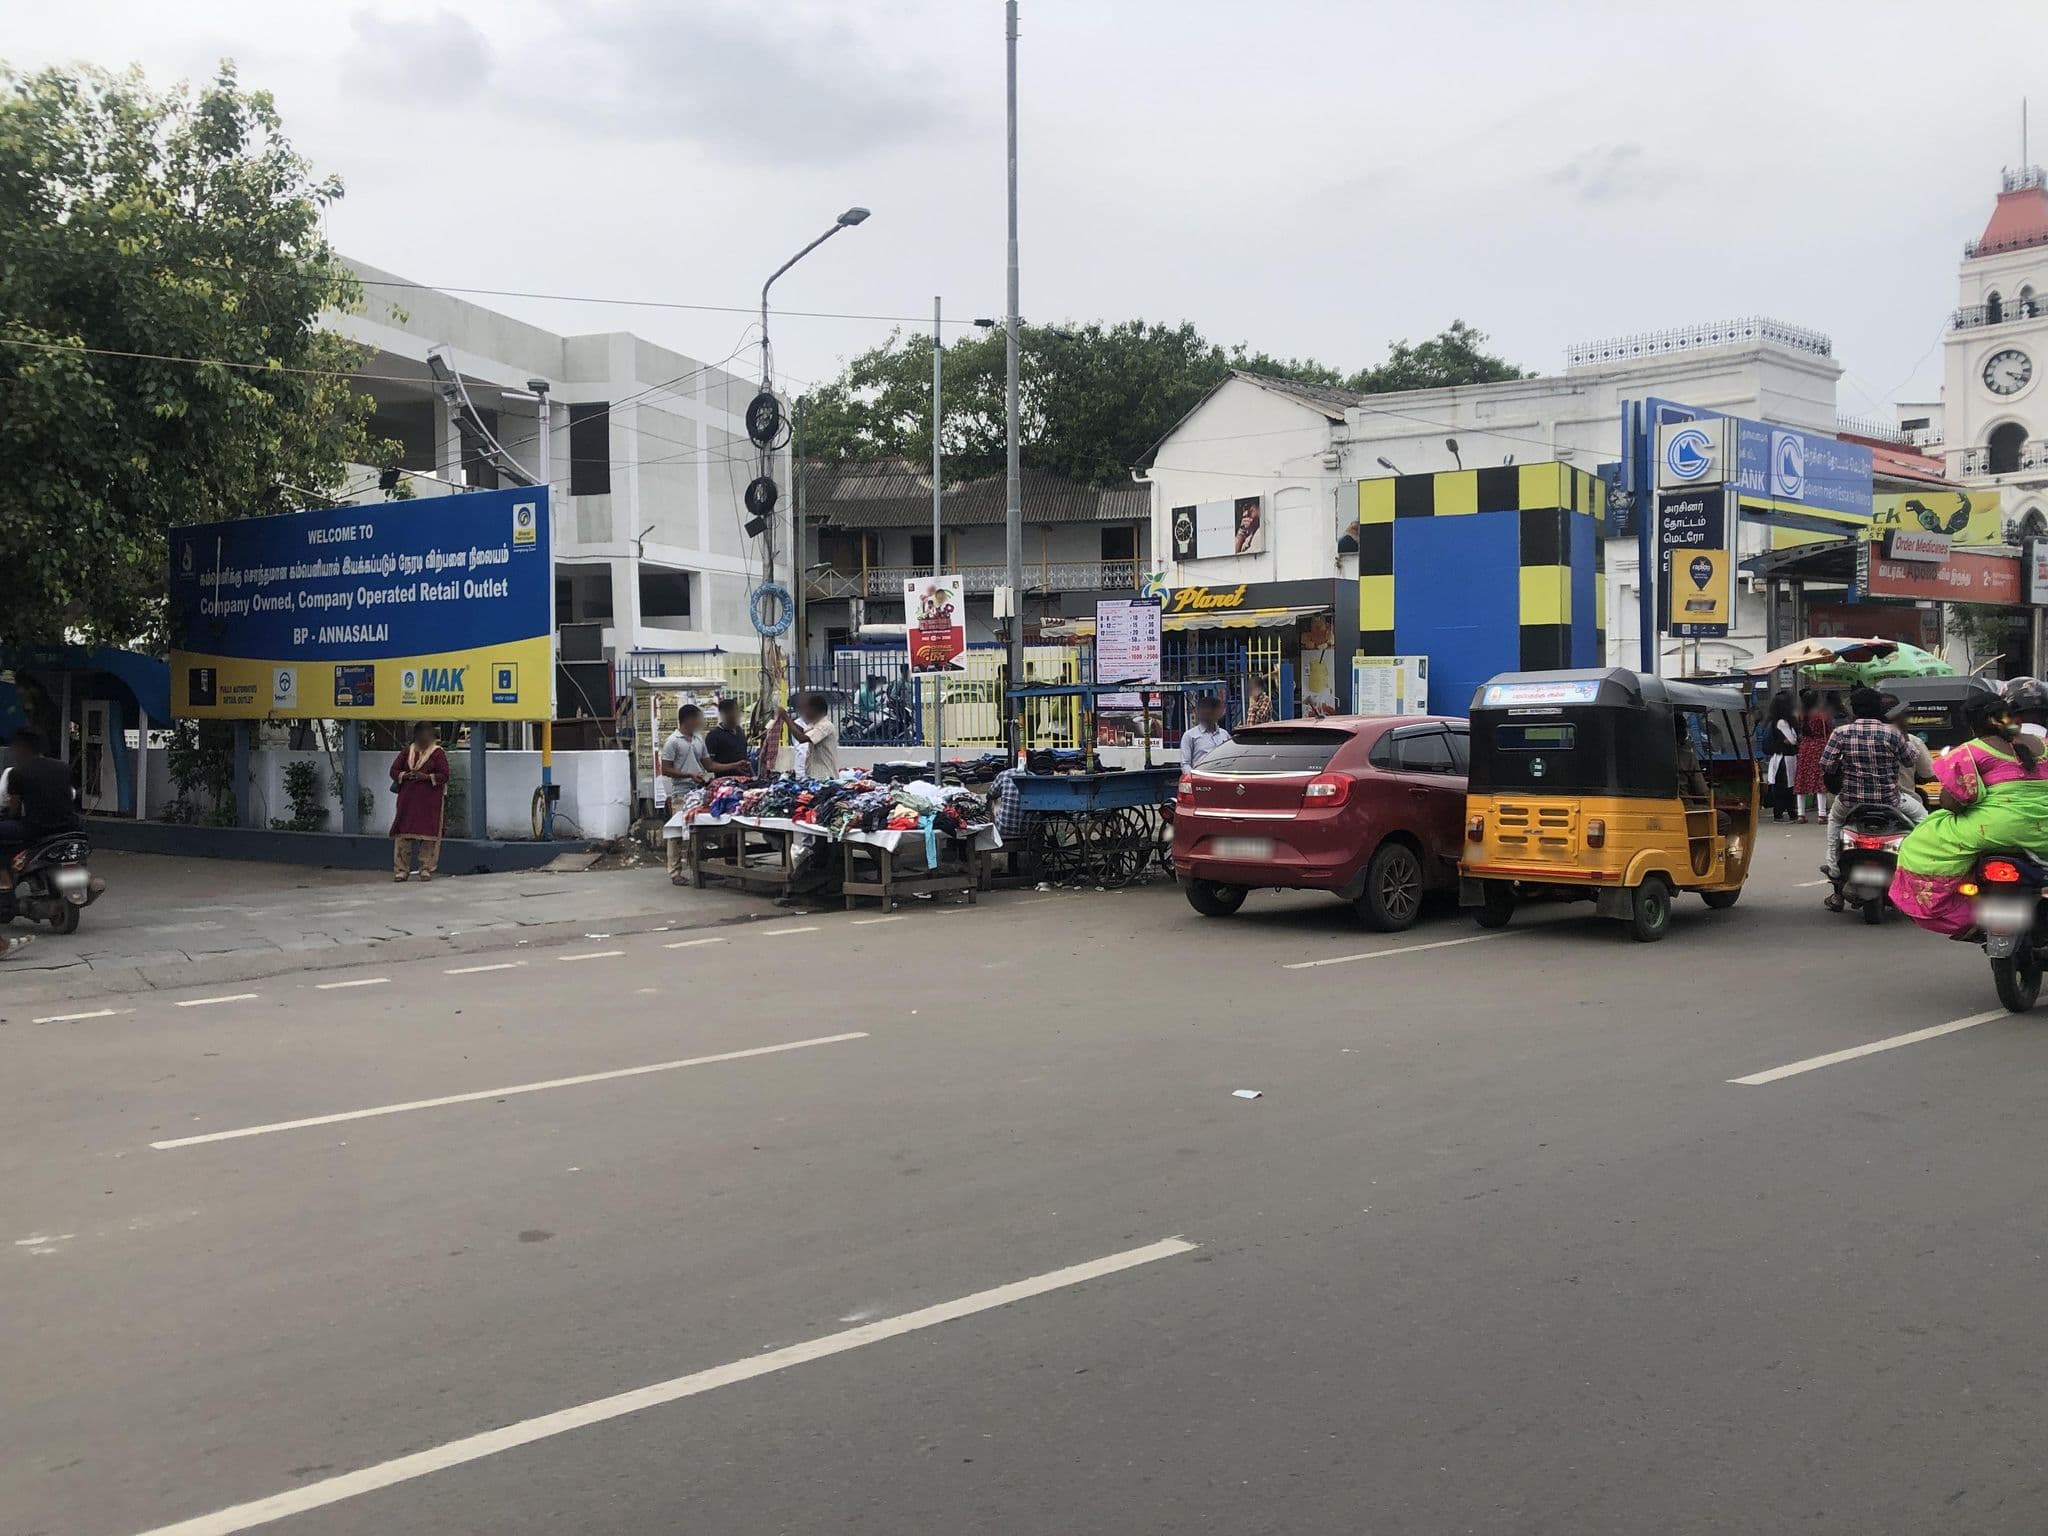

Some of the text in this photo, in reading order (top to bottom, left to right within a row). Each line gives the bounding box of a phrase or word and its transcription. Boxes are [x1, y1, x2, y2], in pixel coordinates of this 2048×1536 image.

[1738, 467, 1765, 491] ANK
[308, 524, 373, 544] WELCOME TO
[1663, 515, 1706, 531] தோட்டம்
[1663, 531, 1705, 544] மெட்ரோ
[1895, 536, 1949, 555] Order Medicines
[342, 552, 396, 577] இயக்கப்படும்
[398, 554, 423, 575] நேரடி
[468, 543, 509, 571] நிலையம்
[200, 577, 508, 617] Company Owned, Company Operated Retail Outlet
[1174, 585, 1248, 611] Planet
[293, 628, 308, 645] BP
[318, 623, 388, 644] ANNASALAI
[421, 667, 466, 692] MAK
[420, 694, 465, 706] LUBRICANTS
